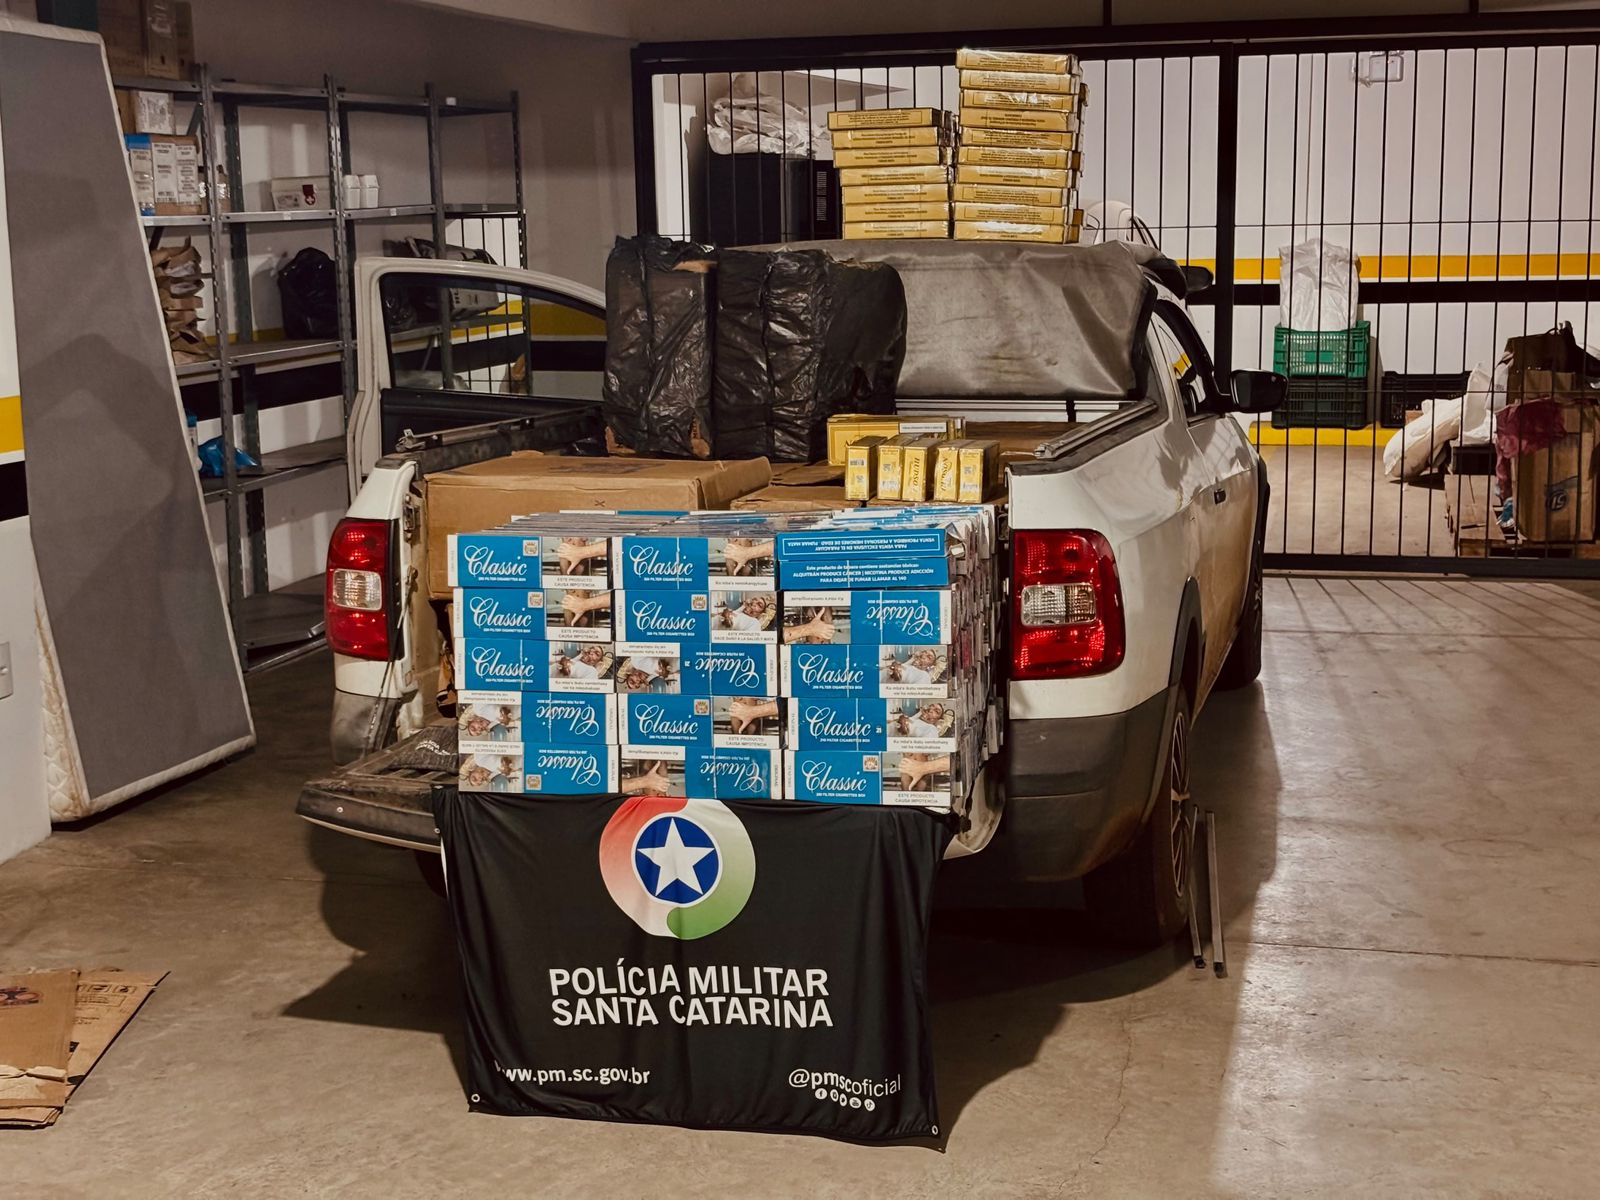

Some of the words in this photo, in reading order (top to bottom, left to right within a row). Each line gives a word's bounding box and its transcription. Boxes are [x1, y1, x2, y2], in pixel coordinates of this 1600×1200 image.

[464, 545, 527, 577] Classic
[629, 545, 694, 577] Classic
[470, 596, 532, 629] Classic
[632, 600, 696, 632] Classic
[866, 603, 934, 636] Classic
[472, 647, 534, 678] Classic
[695, 656, 760, 688] Classic
[798, 653, 864, 685] Classic
[536, 704, 599, 736] Classic
[635, 704, 698, 736] Classic
[805, 706, 871, 739] Classic
[538, 754, 601, 786] Classic
[700, 760, 764, 793] Classic
[802, 760, 867, 793] Classic
[549, 957, 681, 996] POLÍCIA
[688, 965, 829, 997] MILITAR
[551, 997, 659, 1027] SANTA
[669, 995, 833, 1029] CATARINA
[788, 1068, 901, 1097] @pmscoficial
